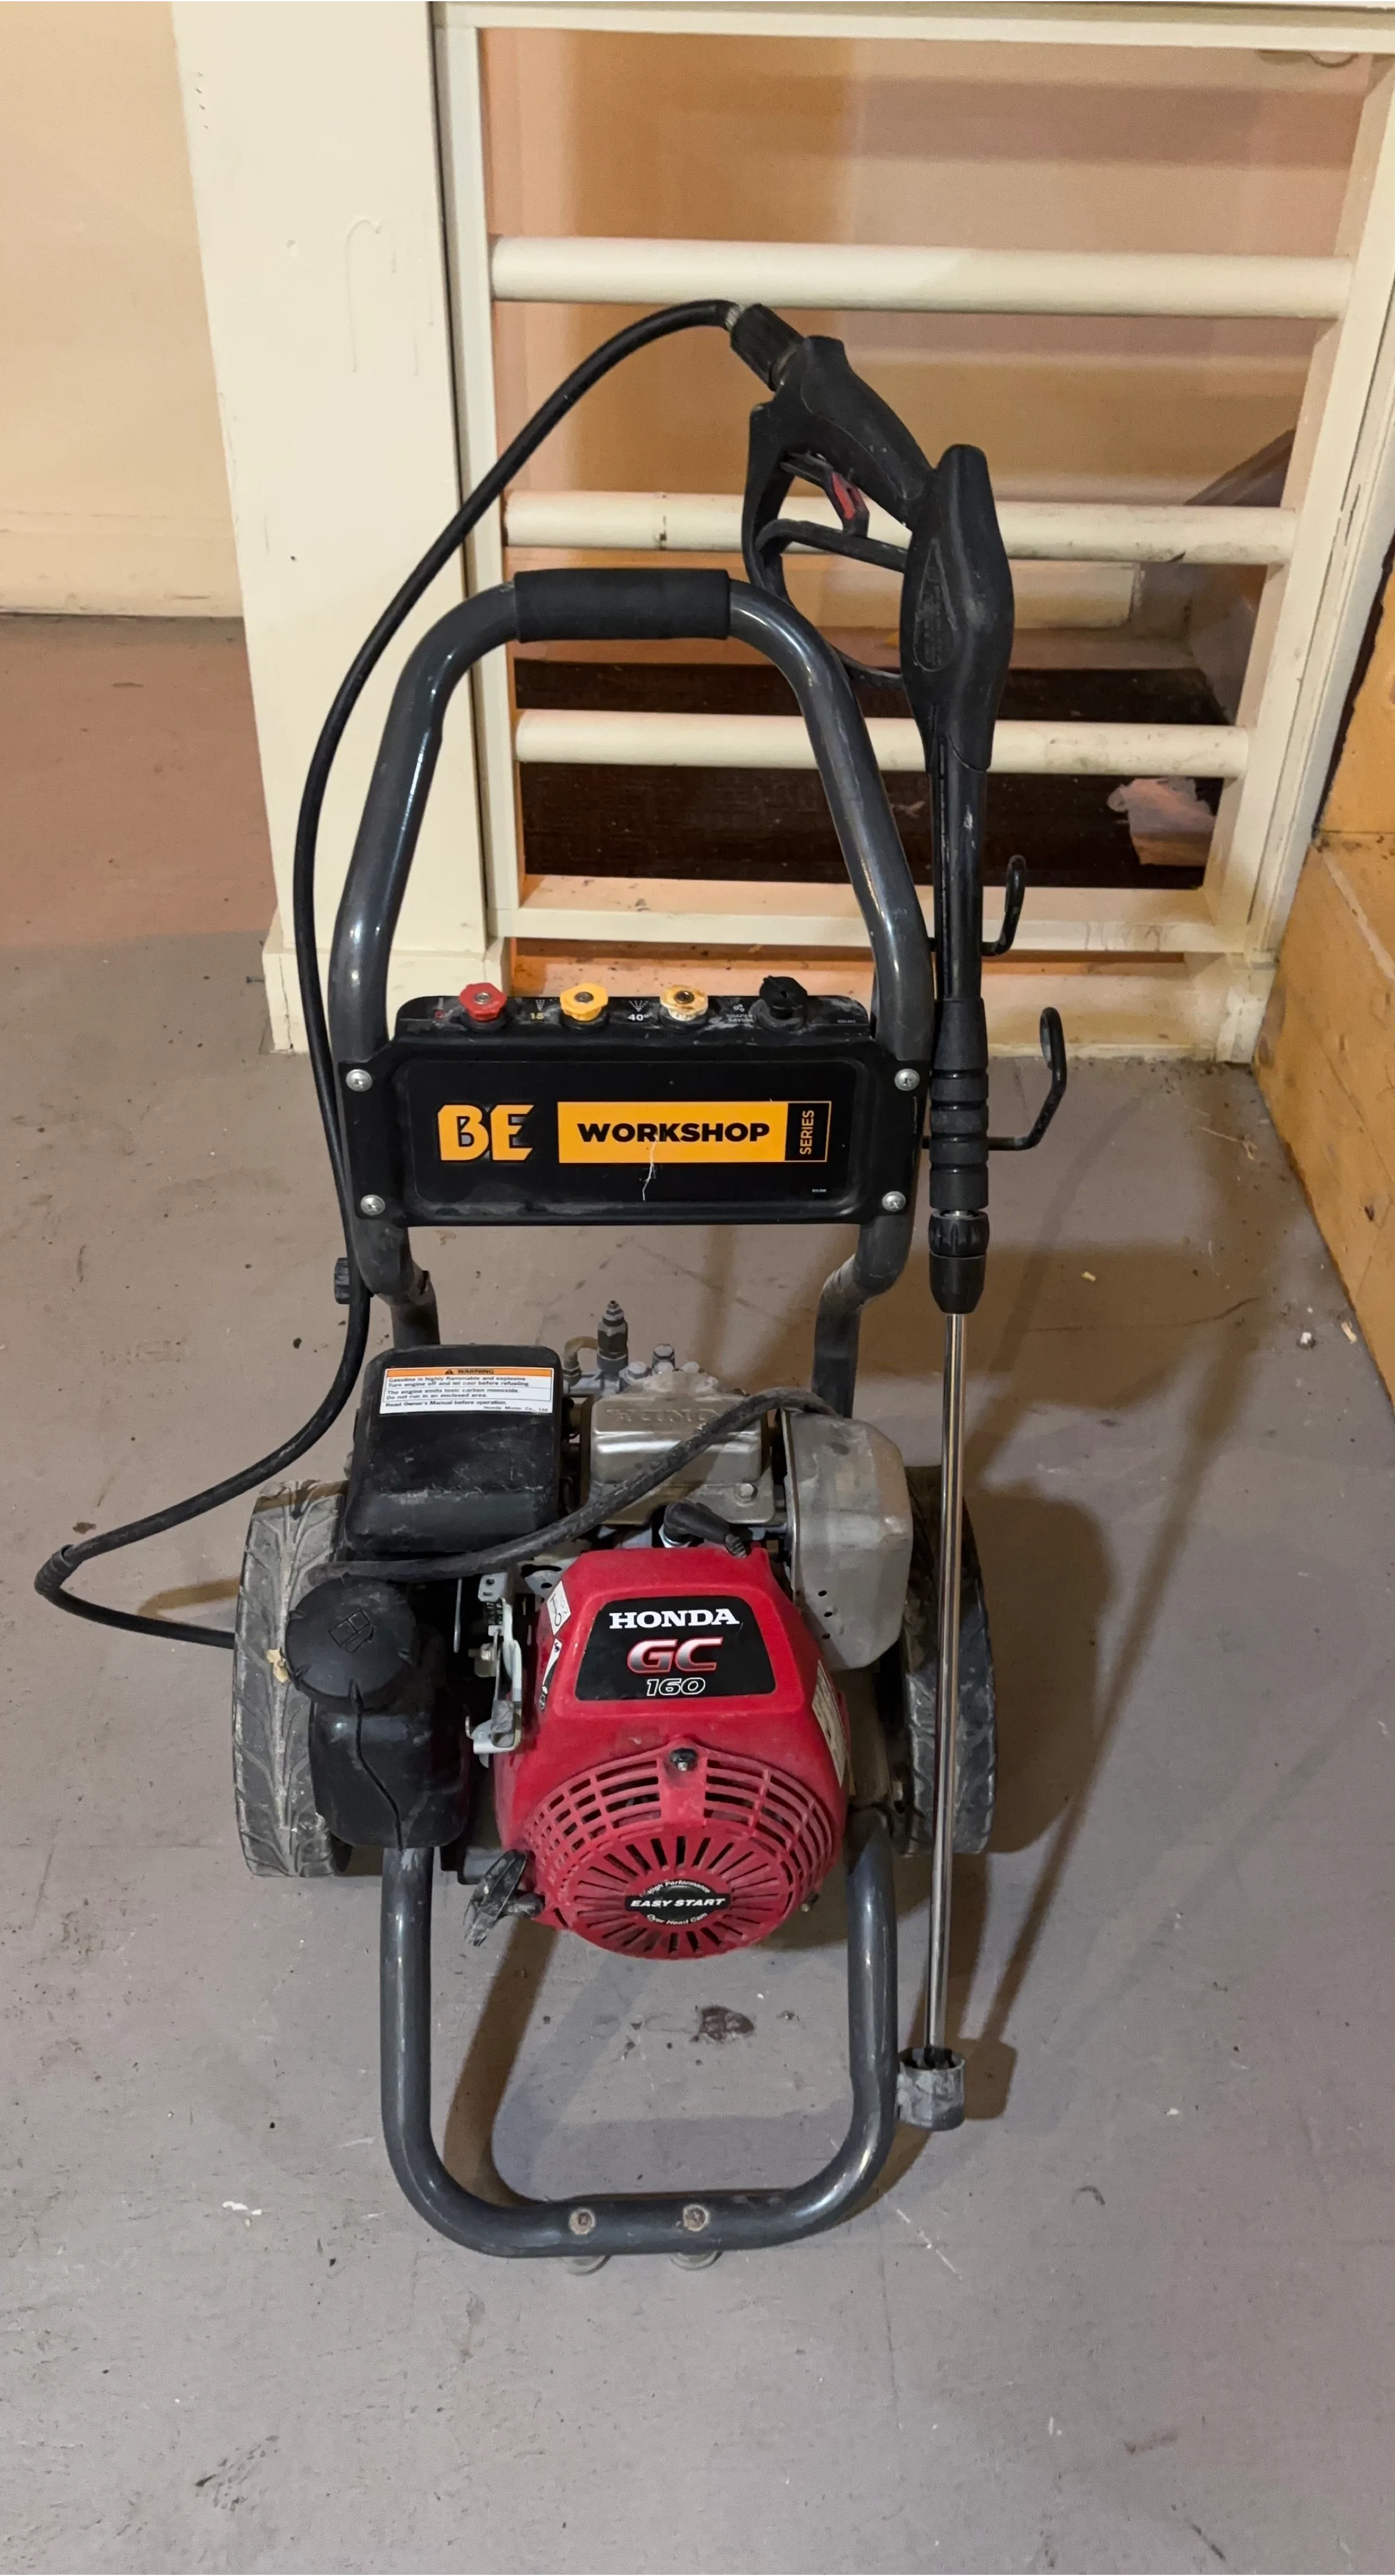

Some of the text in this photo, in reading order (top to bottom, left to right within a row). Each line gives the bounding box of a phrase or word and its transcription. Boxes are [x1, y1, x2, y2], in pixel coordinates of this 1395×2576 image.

[438, 1105, 534, 1160] BE
[577, 1123, 770, 1142] WORKSHOP
[799, 1110, 815, 1154] SERIES
[609, 1608, 740, 1629] HONDA
[627, 1636, 723, 1674] GC
[646, 1677, 706, 1696] 160
